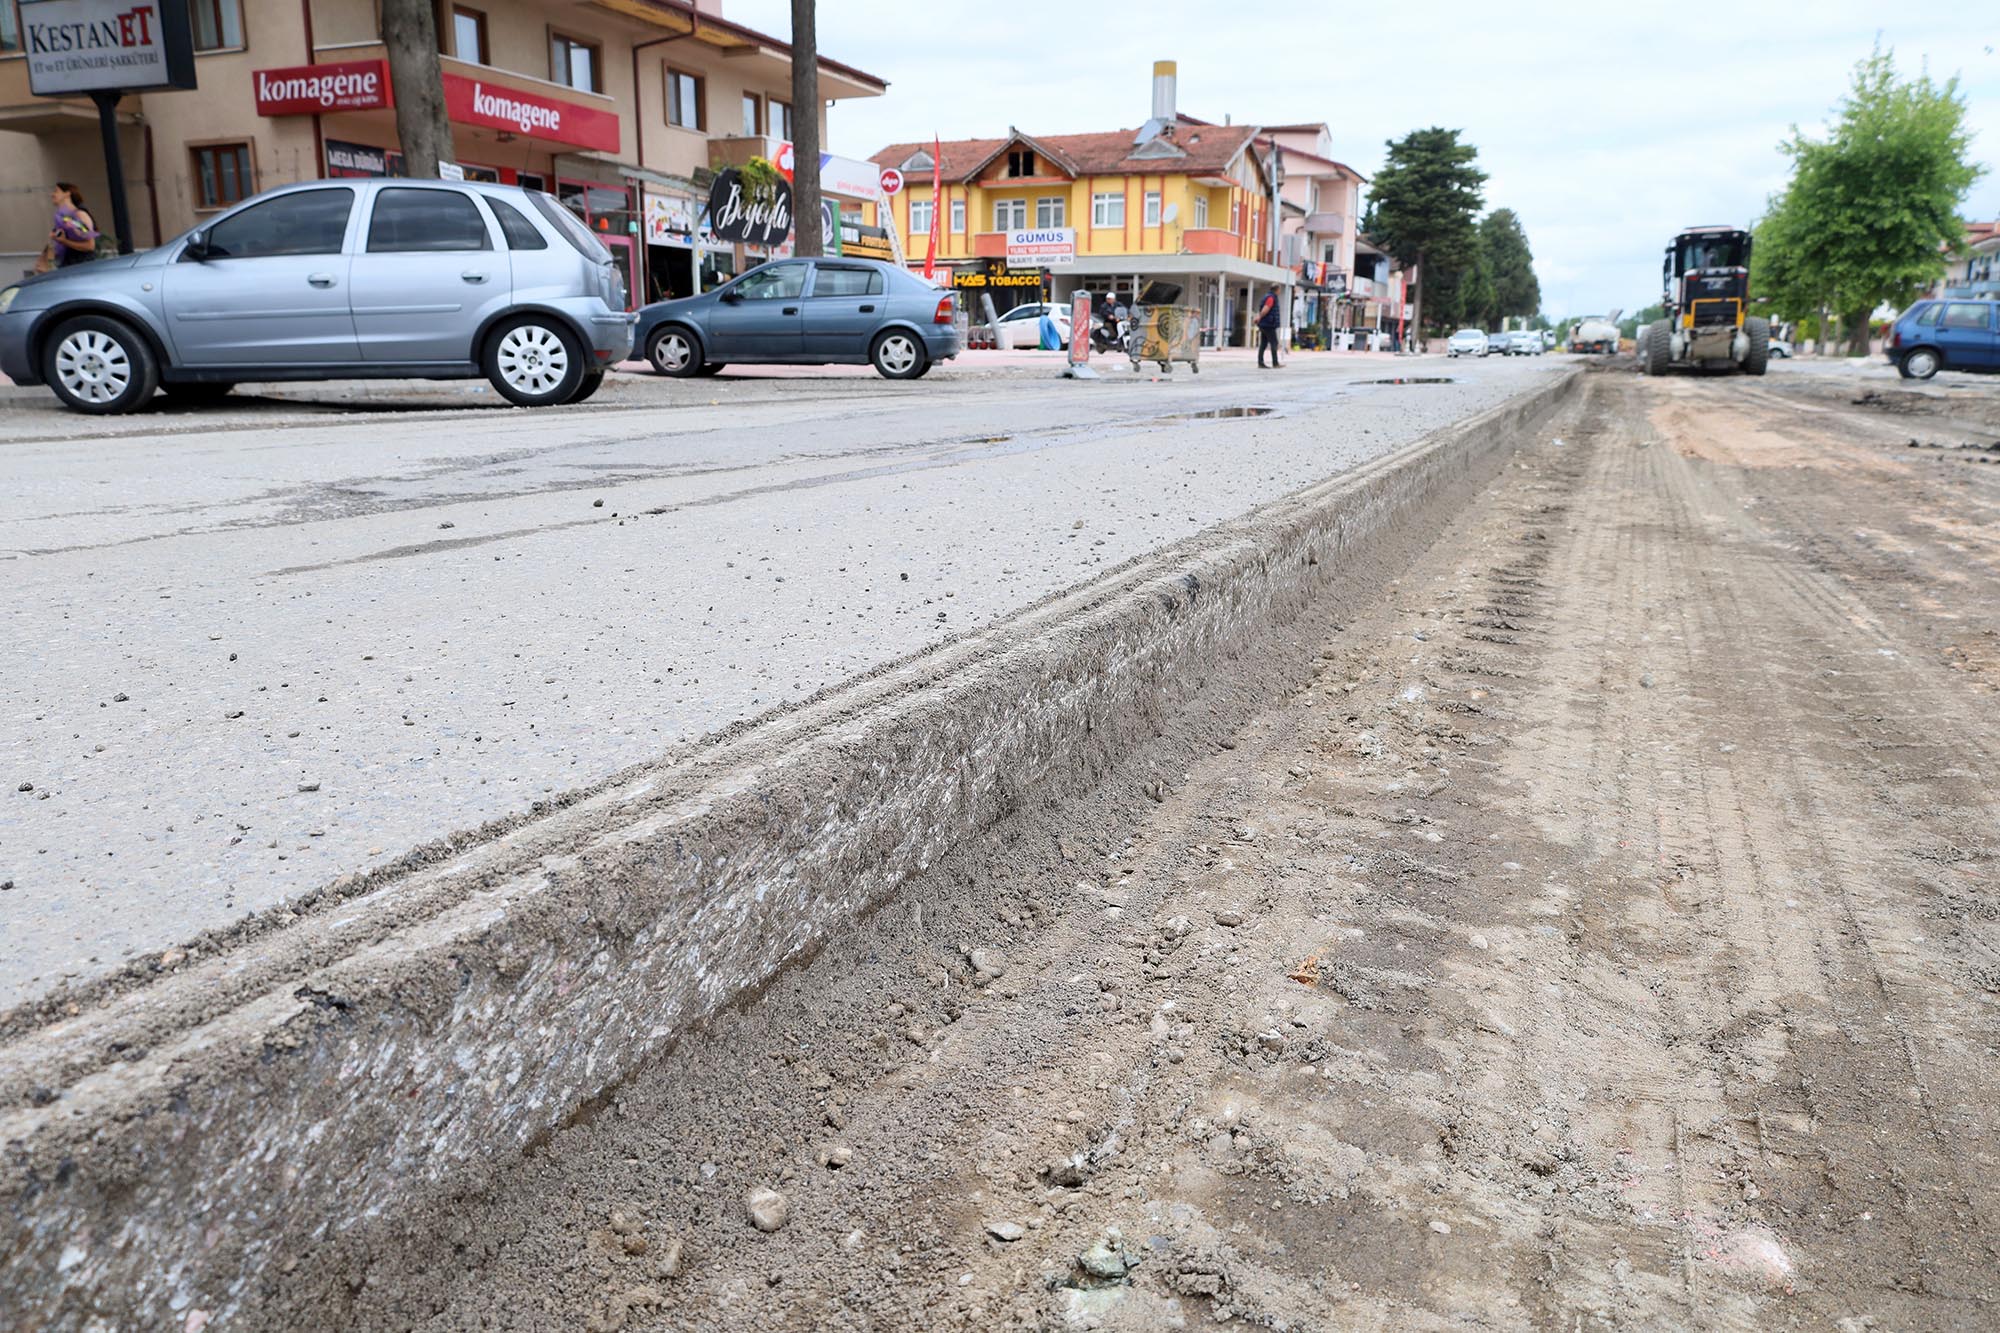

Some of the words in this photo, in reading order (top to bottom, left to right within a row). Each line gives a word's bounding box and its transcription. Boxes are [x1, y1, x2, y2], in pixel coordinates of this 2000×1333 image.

[259, 72, 377, 106] komagene
[473, 82, 560, 132] komagene
[953, 274, 987, 287] HAS
[989, 275, 1041, 287] TOBACCO
